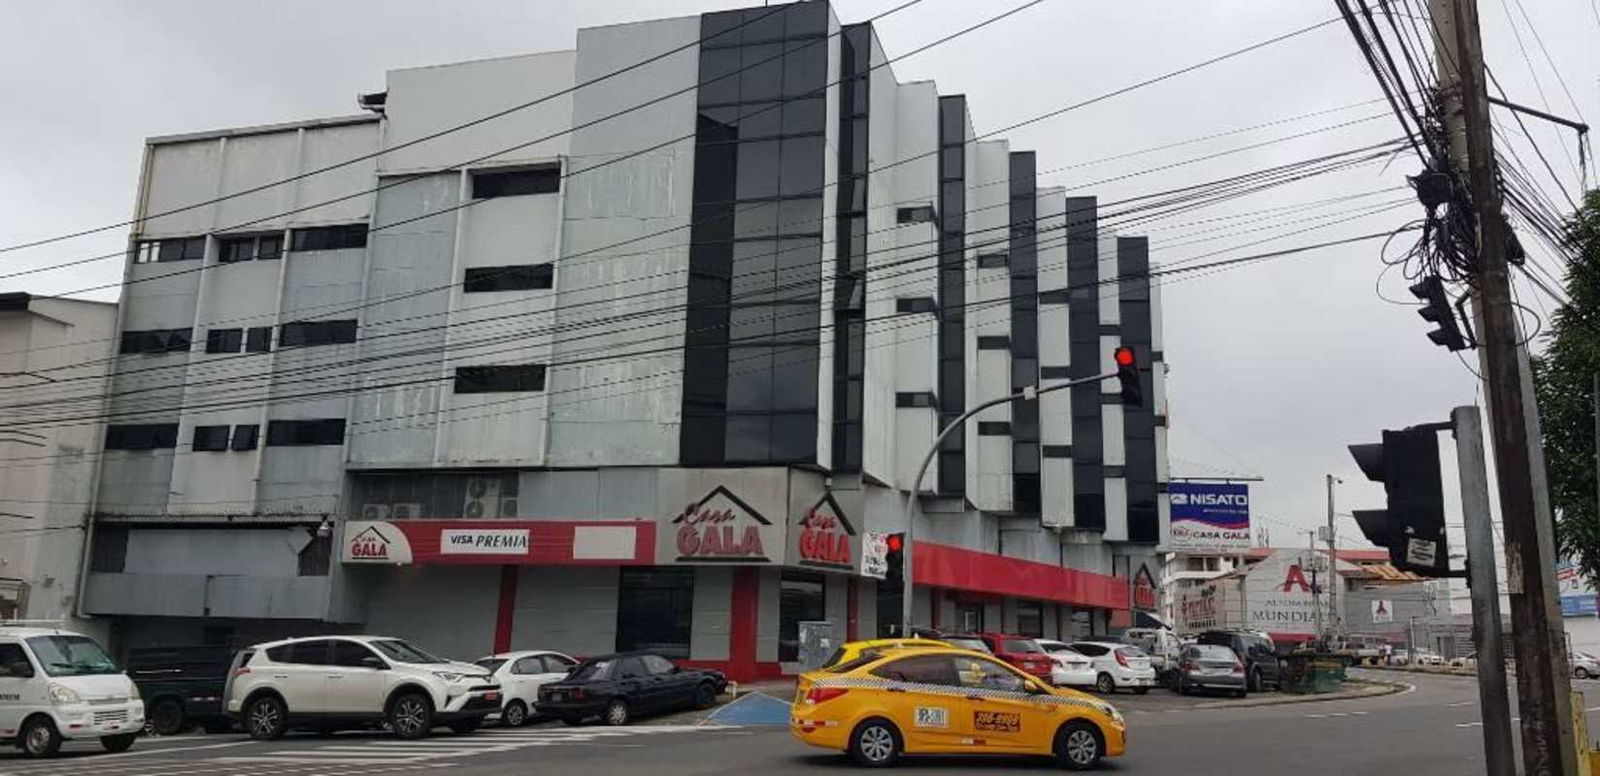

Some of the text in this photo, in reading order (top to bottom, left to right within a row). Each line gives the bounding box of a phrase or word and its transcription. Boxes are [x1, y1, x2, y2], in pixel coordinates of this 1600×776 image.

[1189, 493, 1248, 506] NISATO
[684, 502, 736, 524] Casa
[803, 507, 837, 530] Casa
[450, 534, 527, 549] VISA PREMIA
[676, 525, 765, 557] GALA
[1193, 531, 1221, 540] CASA
[1222, 531, 1251, 540] GALA
[351, 543, 387, 556] GALA
[799, 527, 851, 564] GALA
